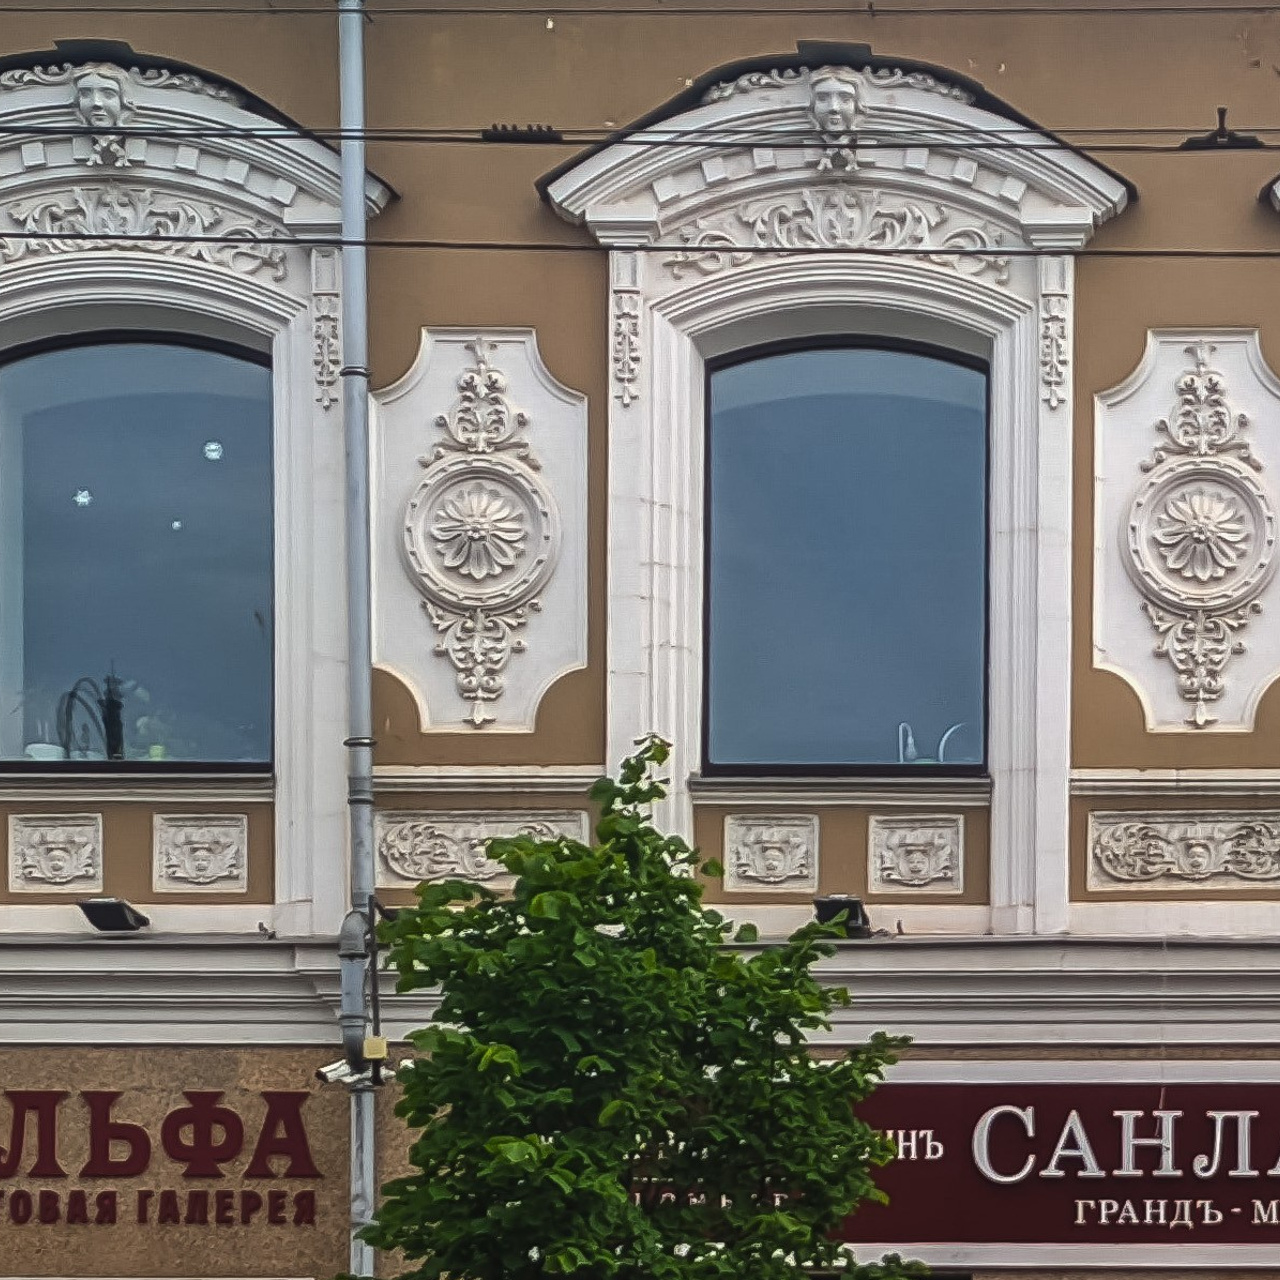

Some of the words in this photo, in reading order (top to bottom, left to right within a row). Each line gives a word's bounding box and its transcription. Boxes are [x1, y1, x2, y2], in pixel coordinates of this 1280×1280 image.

[0, 1090, 324, 1178] ЛЬФА
[0, 1189, 117, 1225] ОВАЯ
[137, 1189, 316, 1225] ГАЛЕРЕЯ
